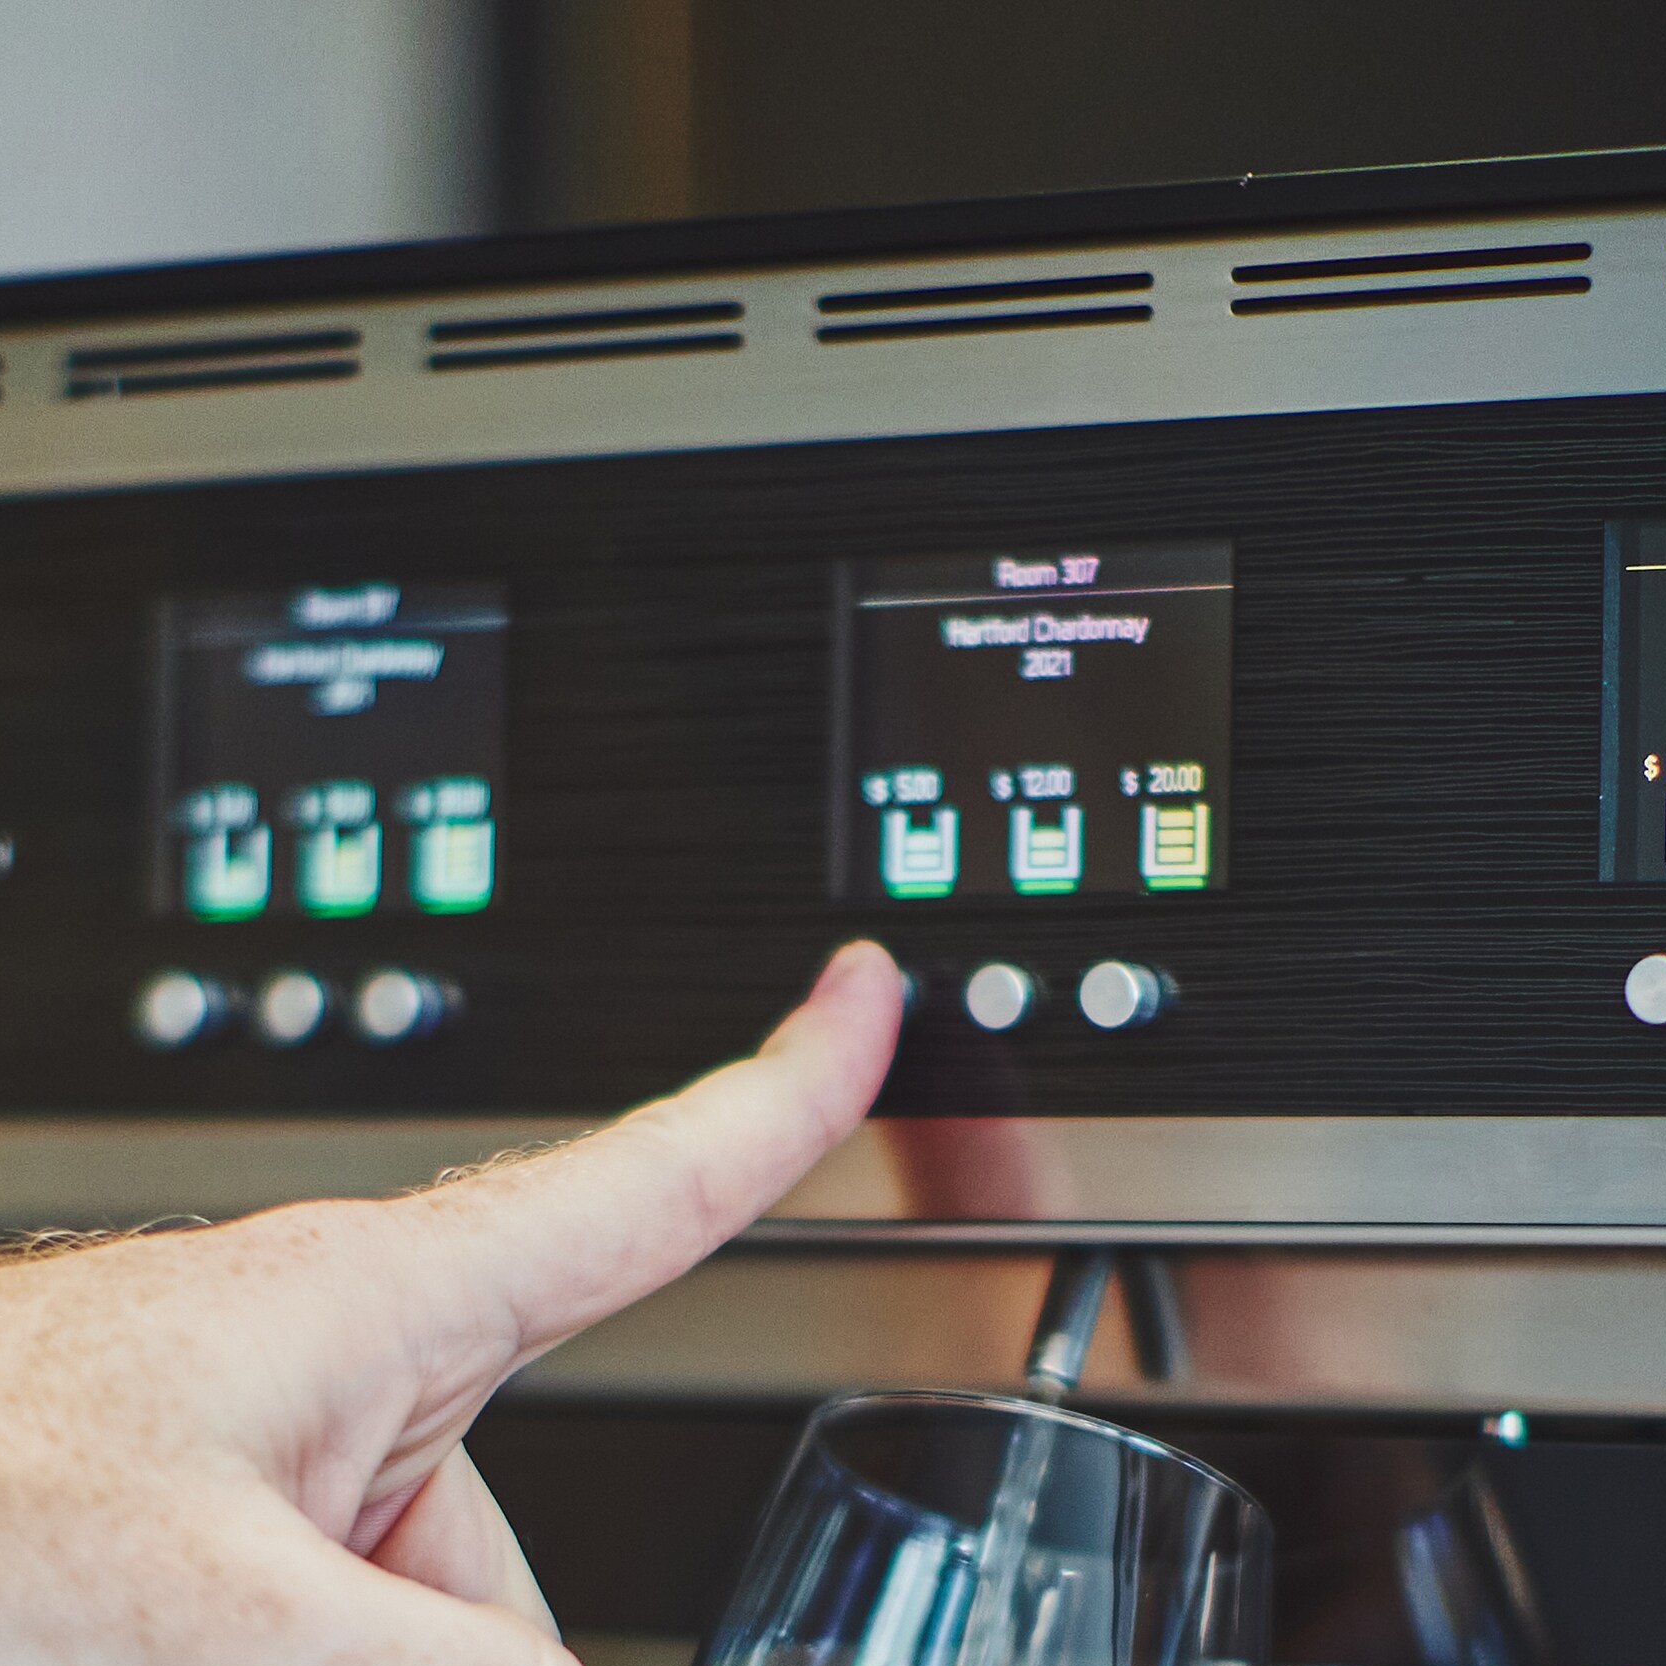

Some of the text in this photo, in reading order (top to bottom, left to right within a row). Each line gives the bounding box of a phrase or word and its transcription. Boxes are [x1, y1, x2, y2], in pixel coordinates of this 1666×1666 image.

[994, 555, 1100, 587] Room 307
[942, 616, 1150, 647] Hartford Chardonnay
[1021, 650, 1074, 678] 2021
[1147, 763, 1203, 795] 20.00
[1644, 752, 1660, 782] $
